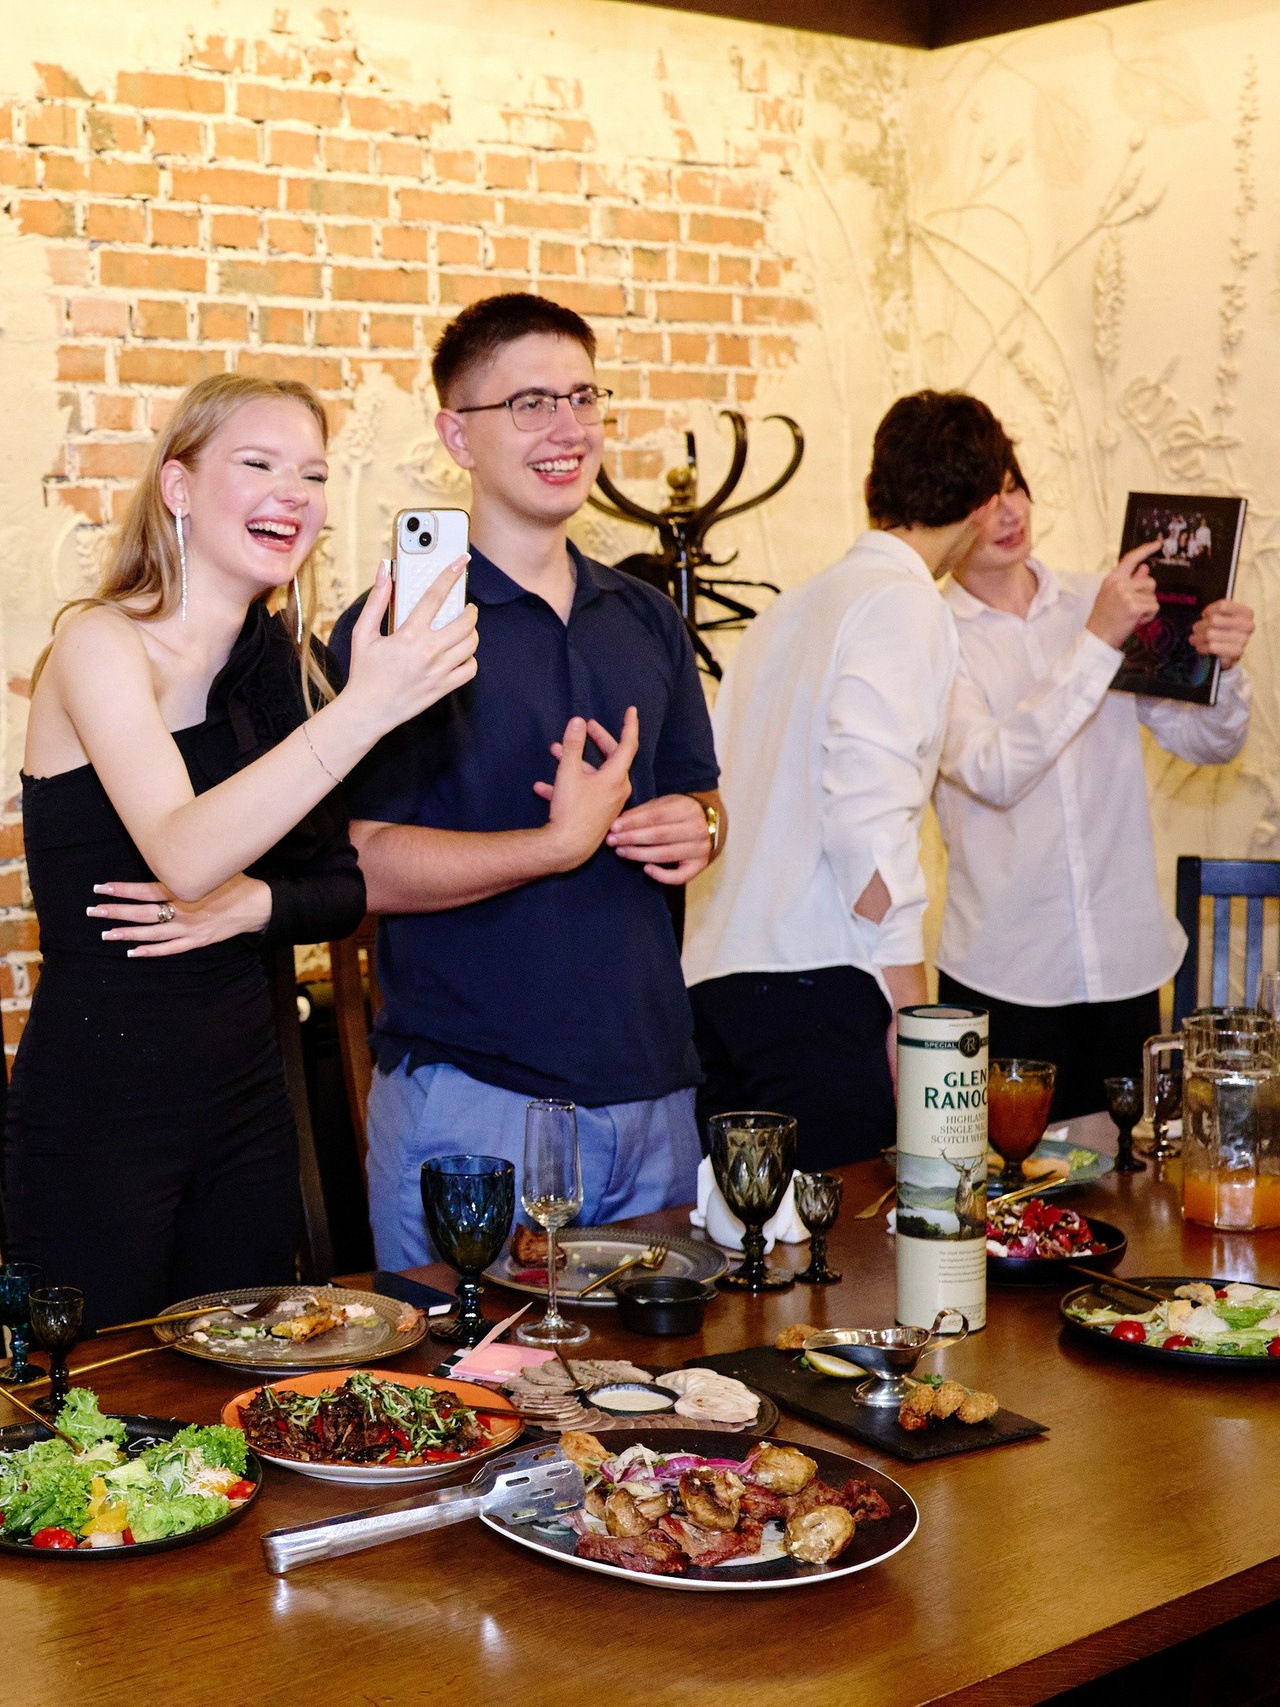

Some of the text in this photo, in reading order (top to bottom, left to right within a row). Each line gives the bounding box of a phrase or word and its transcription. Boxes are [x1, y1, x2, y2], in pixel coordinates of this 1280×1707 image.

[924, 1041, 957, 1049] SPECIAL
[943, 1068, 988, 1087] GLEN
[940, 1125, 973, 1134] SINGLE
[931, 1135, 969, 1144] SCOTCH
